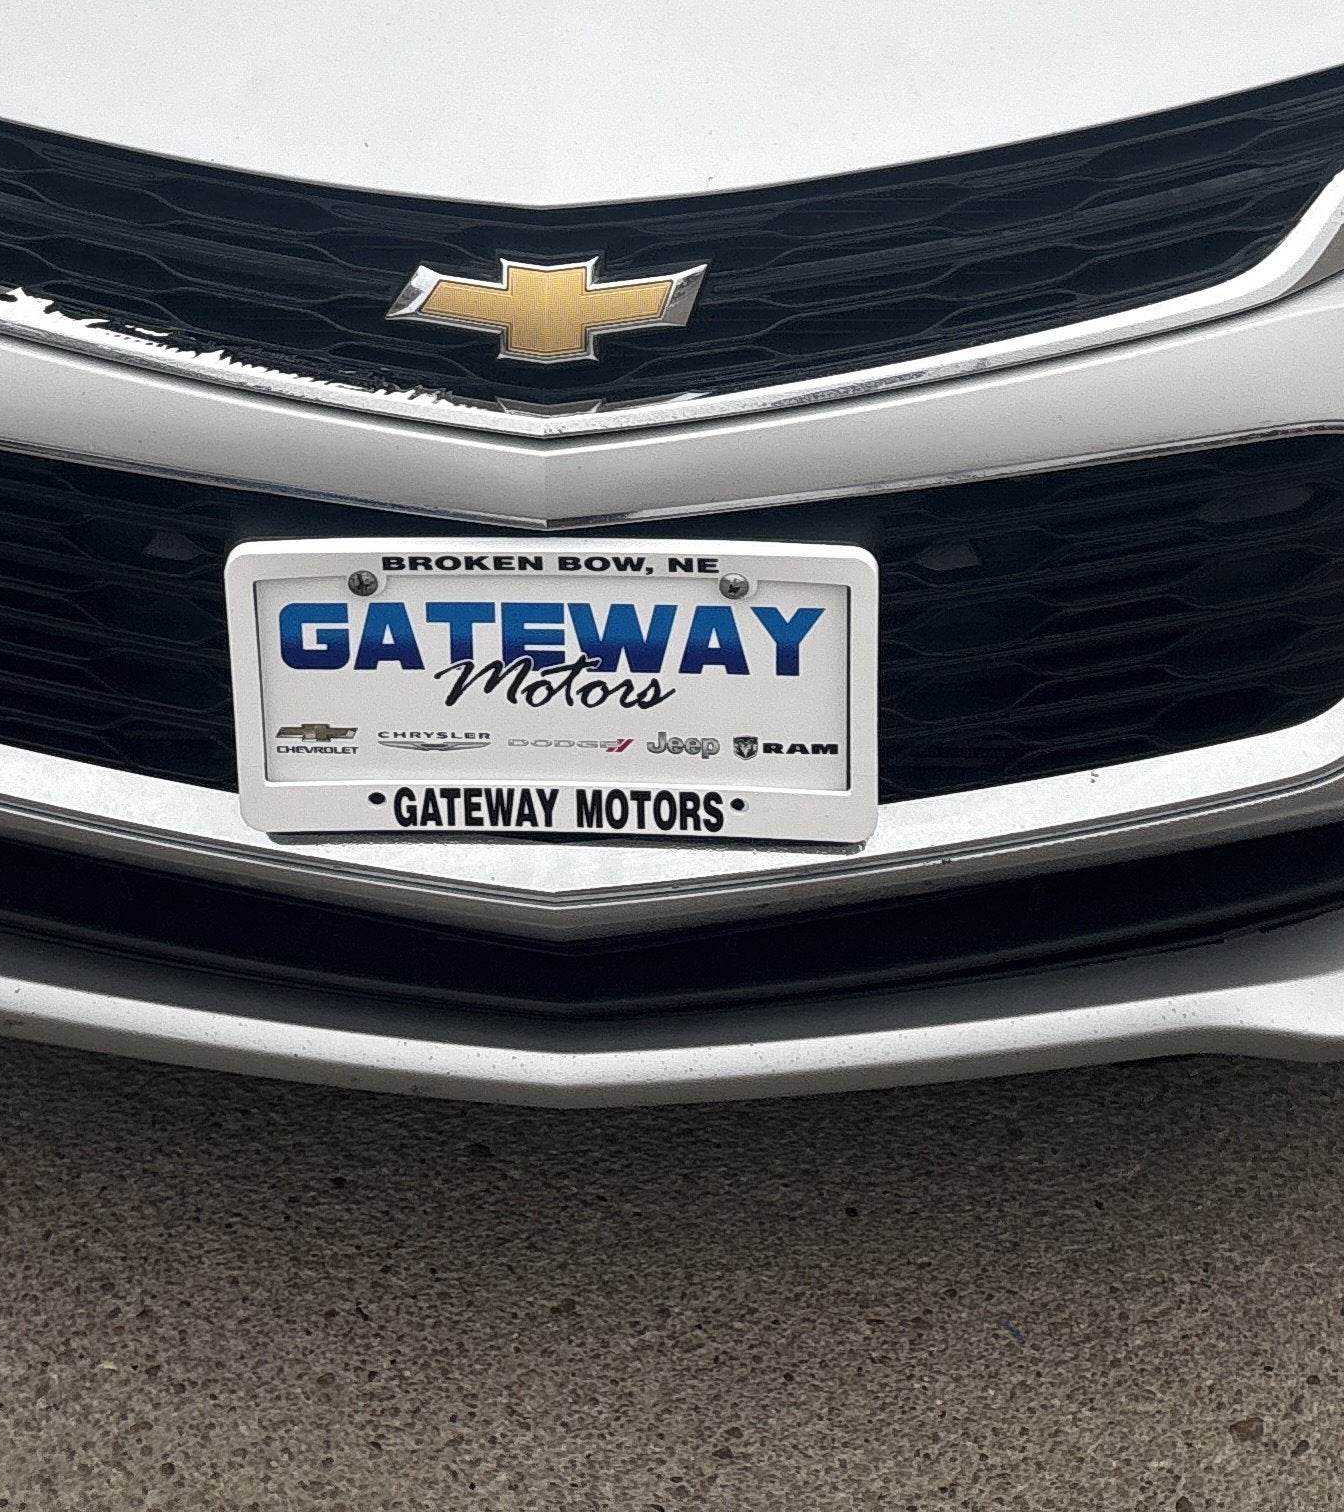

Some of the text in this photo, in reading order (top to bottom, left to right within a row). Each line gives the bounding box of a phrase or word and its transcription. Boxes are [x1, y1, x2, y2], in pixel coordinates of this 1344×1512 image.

[381, 555, 721, 575] BROKEN BOW, NE
[278, 601, 827, 677] GATEWAY
[433, 653, 676, 710] Motors
[377, 731, 492, 740] CHRYSLER
[507, 738, 618, 750] DODGE
[646, 731, 721, 759] Jeep
[275, 744, 360, 755] CHEVROLET
[762, 742, 839, 756] RAM
[393, 786, 725, 833] GATEWAY MOTORS
